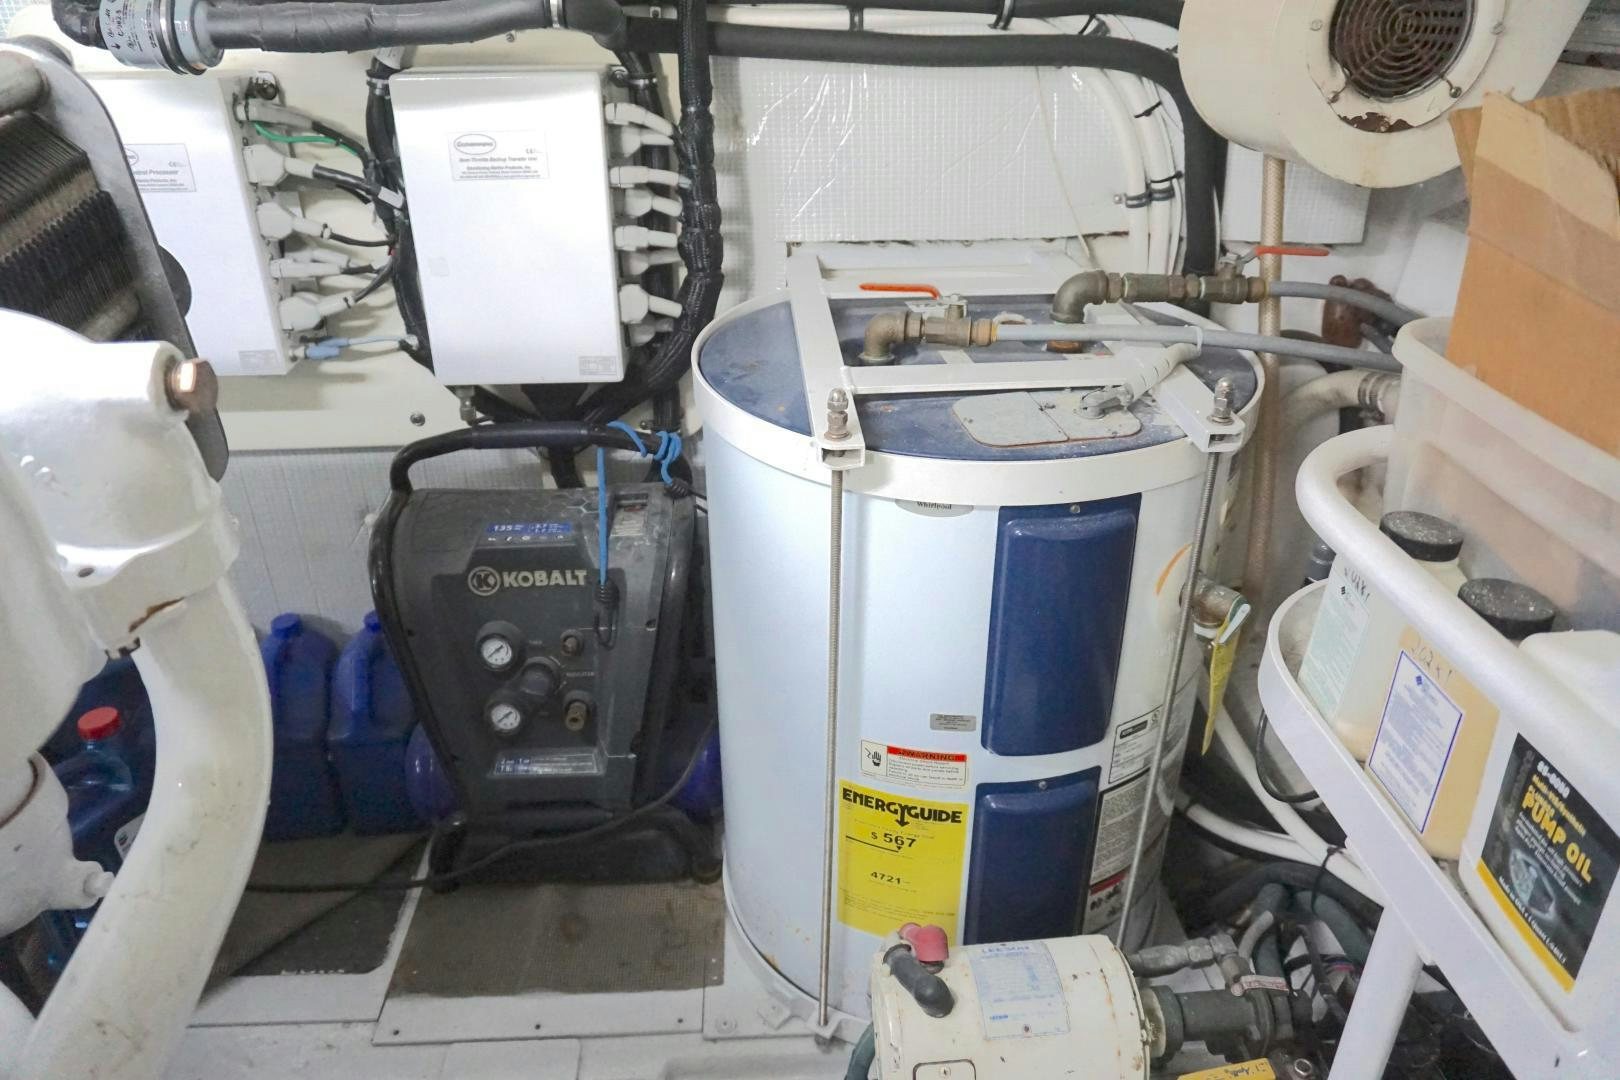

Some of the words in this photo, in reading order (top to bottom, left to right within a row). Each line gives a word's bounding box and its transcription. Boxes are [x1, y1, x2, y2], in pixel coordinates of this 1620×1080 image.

[503, 570, 587, 587] KOBALT
[904, 751, 955, 761] WARNING
[883, 833, 917, 848] 567
[1522, 789, 1566, 845] PUMP
[1566, 842, 1592, 884] OIL
[870, 871, 901, 884] 4721
